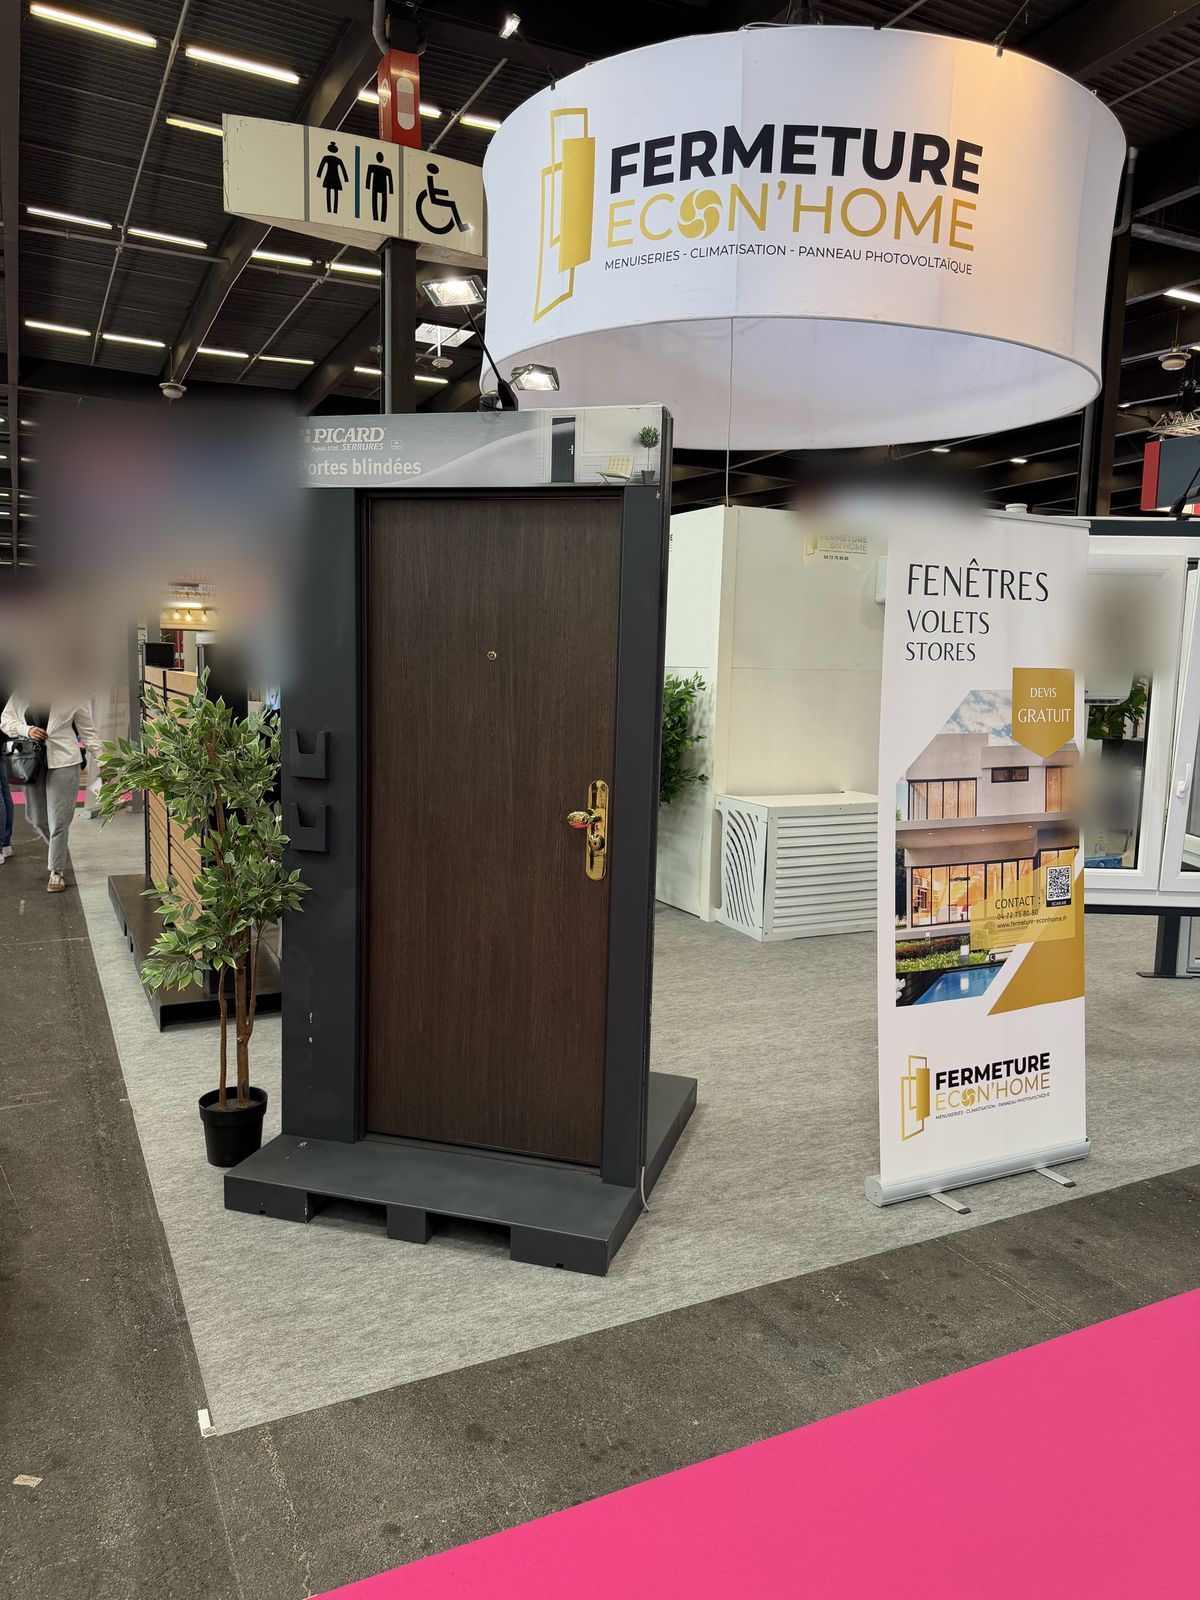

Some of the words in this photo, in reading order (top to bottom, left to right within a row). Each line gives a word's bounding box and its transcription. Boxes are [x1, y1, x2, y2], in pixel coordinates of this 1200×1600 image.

[609, 123, 984, 195] FERMETURE
[604, 250, 680, 271] MENUISERIES
[690, 243, 787, 259] CLIMATISATION
[798, 245, 862, 261] PANNEAU
[865, 250, 973, 275] PHOTOVOLTAÏQUE
[312, 427, 385, 443] PICARD
[341, 442, 384, 451] SERRURES
[352, 457, 421, 475] blindées
[907, 558, 1049, 602] FENÊTRES
[907, 609, 990, 635] VOLETS
[905, 642, 976, 662] STORES
[1030, 687, 1057, 699] DEVIS
[1017, 708, 1072, 724] GRATUIT
[995, 895, 1036, 910] CONTACT
[935, 1052, 1051, 1091] FERMETURE
